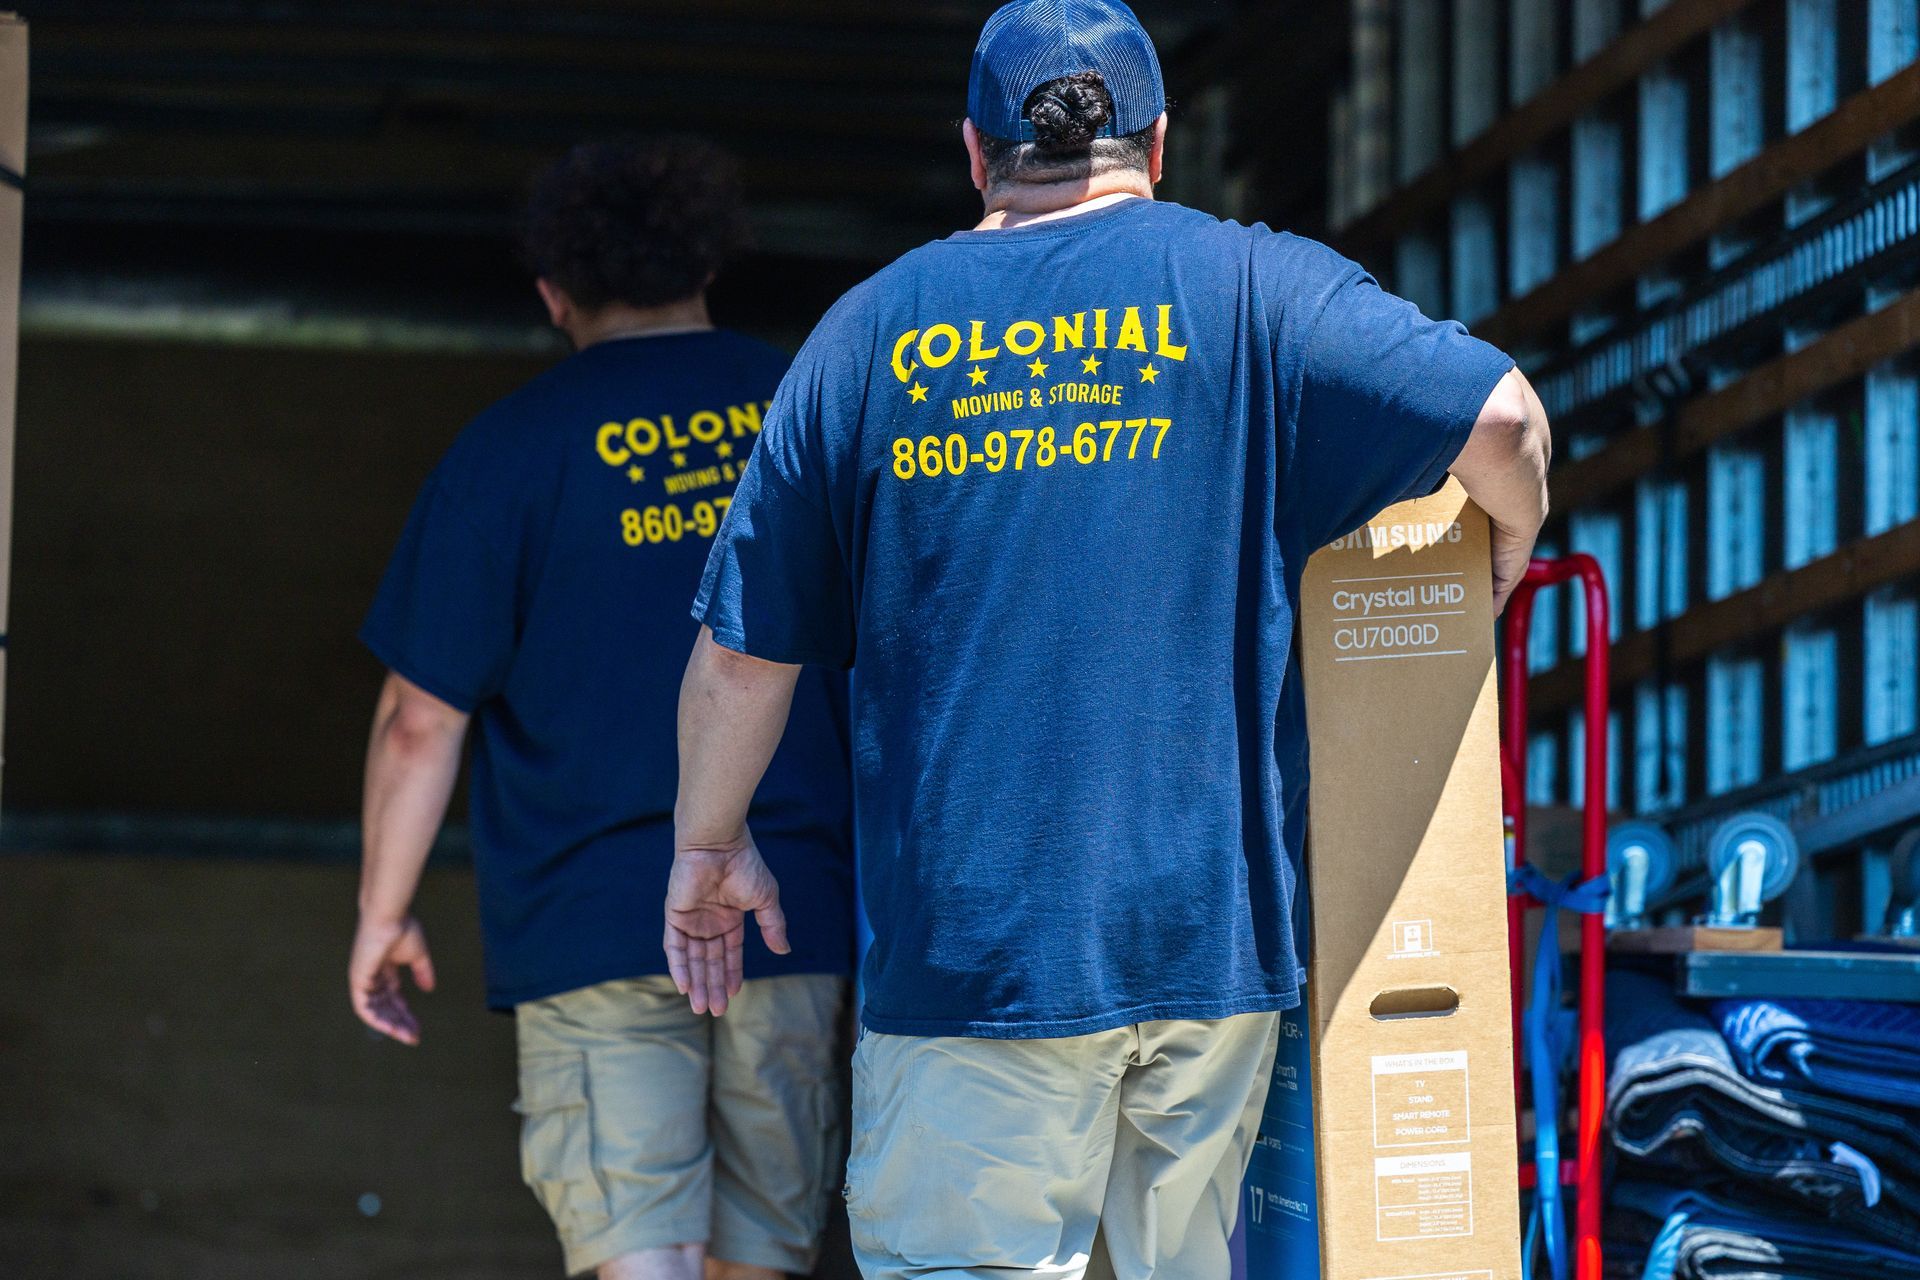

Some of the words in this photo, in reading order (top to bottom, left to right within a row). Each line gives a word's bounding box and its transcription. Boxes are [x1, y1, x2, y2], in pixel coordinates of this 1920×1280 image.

[890, 304, 1188, 384] COLONIAL
[952, 389, 1023, 419] MOVING
[1029, 387, 1043, 408] &
[1049, 382, 1124, 406] STORAGE
[595, 401, 772, 467] COLON
[892, 418, 1172, 480] 860-978-6777
[664, 465, 721, 495] MOVING
[721, 463, 735, 481] &
[1332, 585, 1416, 616] Crystal
[1420, 583, 1466, 605] UHD
[1334, 623, 1440, 650] CU7000D
[1408, 1095, 1434, 1104] STAND
[1415, 1080, 1425, 1088] TV
[1392, 1111, 1419, 1121] SMART
[1420, 1109, 1451, 1119] REMOTE
[1395, 1127, 1424, 1136] POWER
[1425, 1125, 1448, 1134] CORD
[1399, 1159, 1447, 1170] DIMENSIONS
[1250, 1185, 1264, 1224] 17
